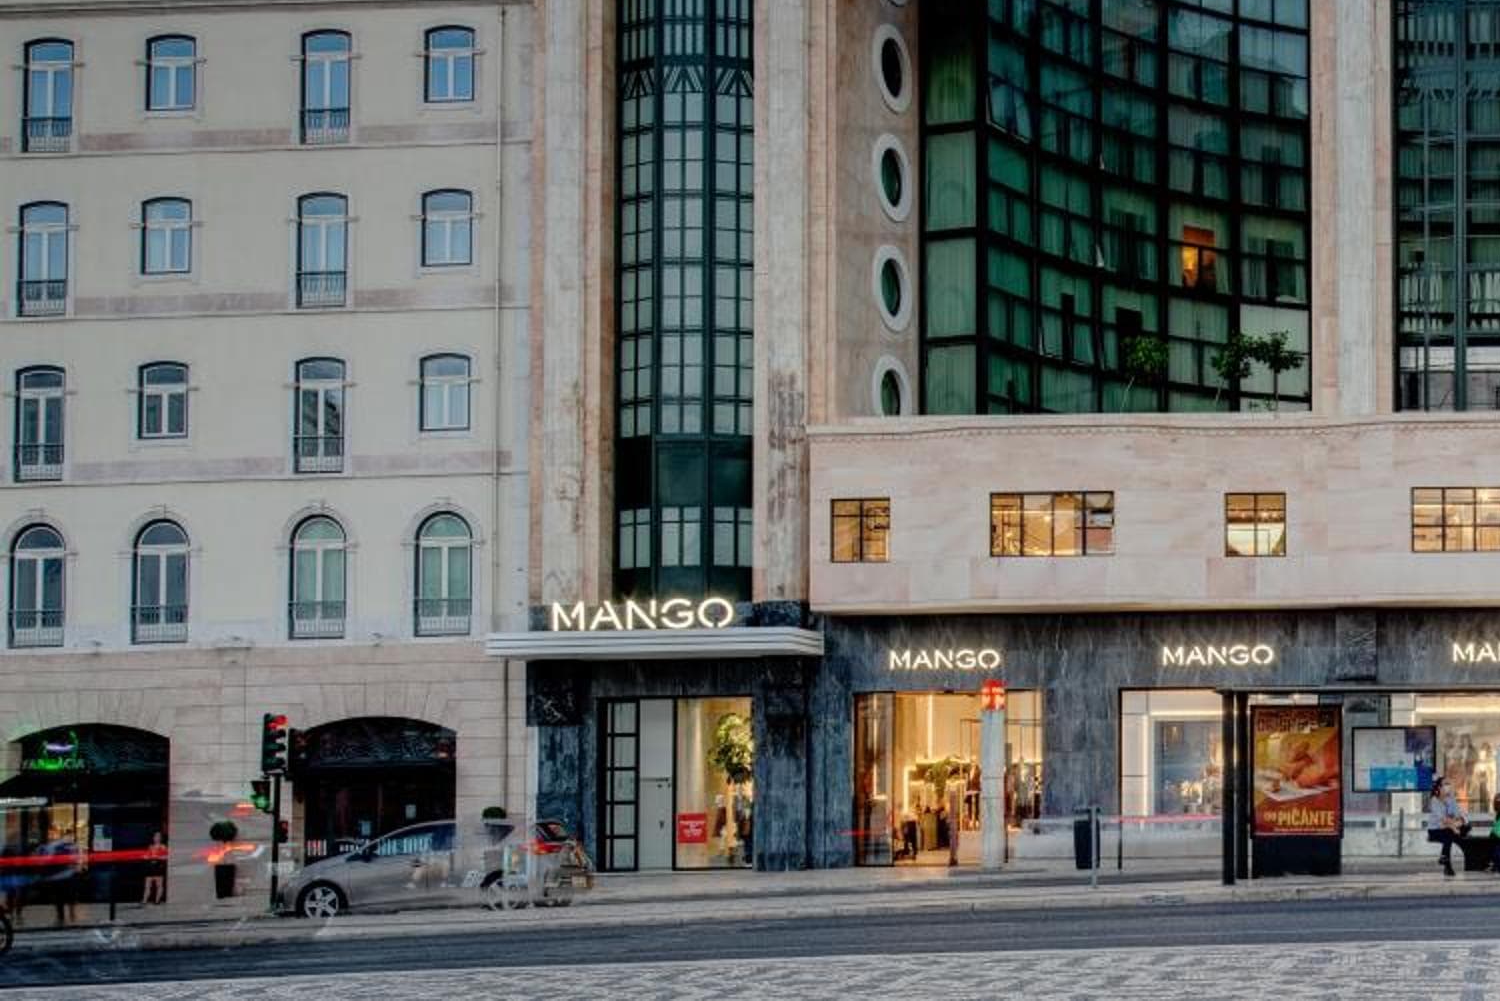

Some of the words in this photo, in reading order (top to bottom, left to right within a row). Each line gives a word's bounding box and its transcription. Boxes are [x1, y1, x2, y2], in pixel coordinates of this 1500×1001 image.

[552, 597, 734, 631] MANGO
[889, 648, 1001, 671] MANGO
[1162, 644, 1275, 666] MANGO
